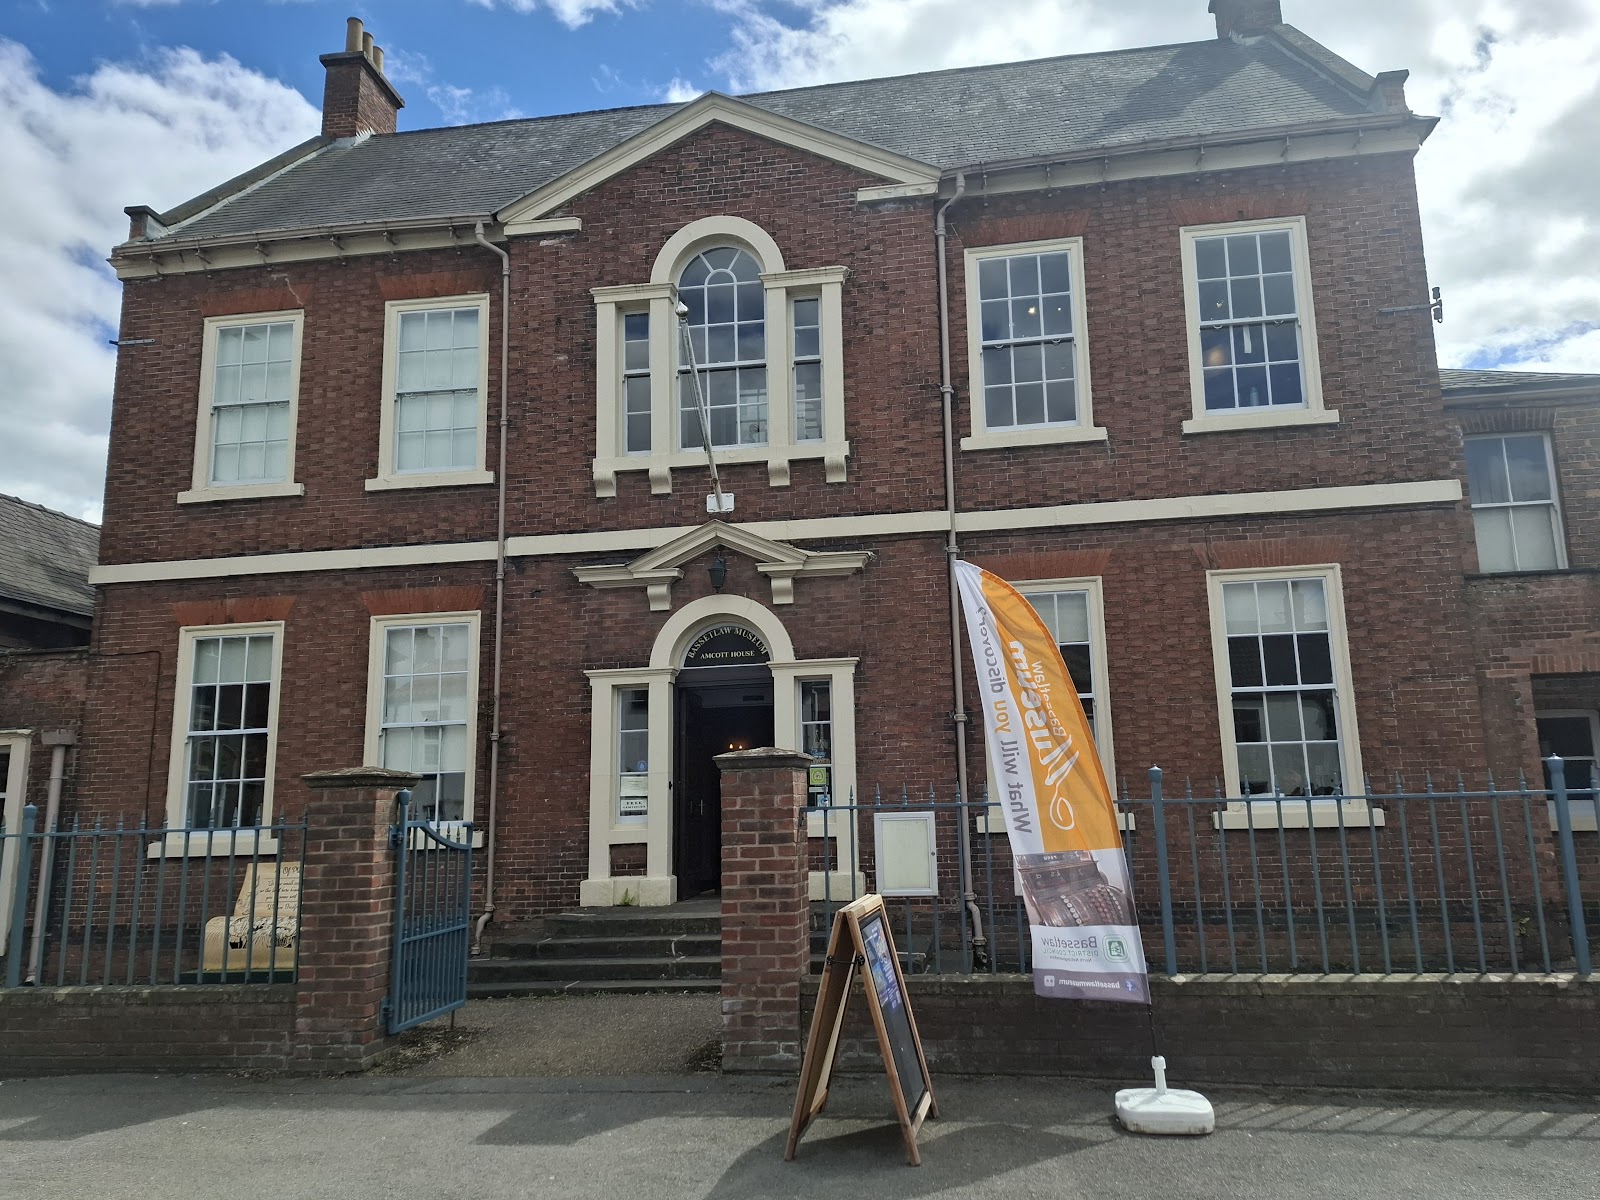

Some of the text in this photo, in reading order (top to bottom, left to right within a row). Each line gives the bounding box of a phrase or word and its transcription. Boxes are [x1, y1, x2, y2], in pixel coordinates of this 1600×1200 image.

[688, 627, 768, 659] BASSETLAW MUSEUM
[700, 650, 756, 659] AMCOTT HOUSE
